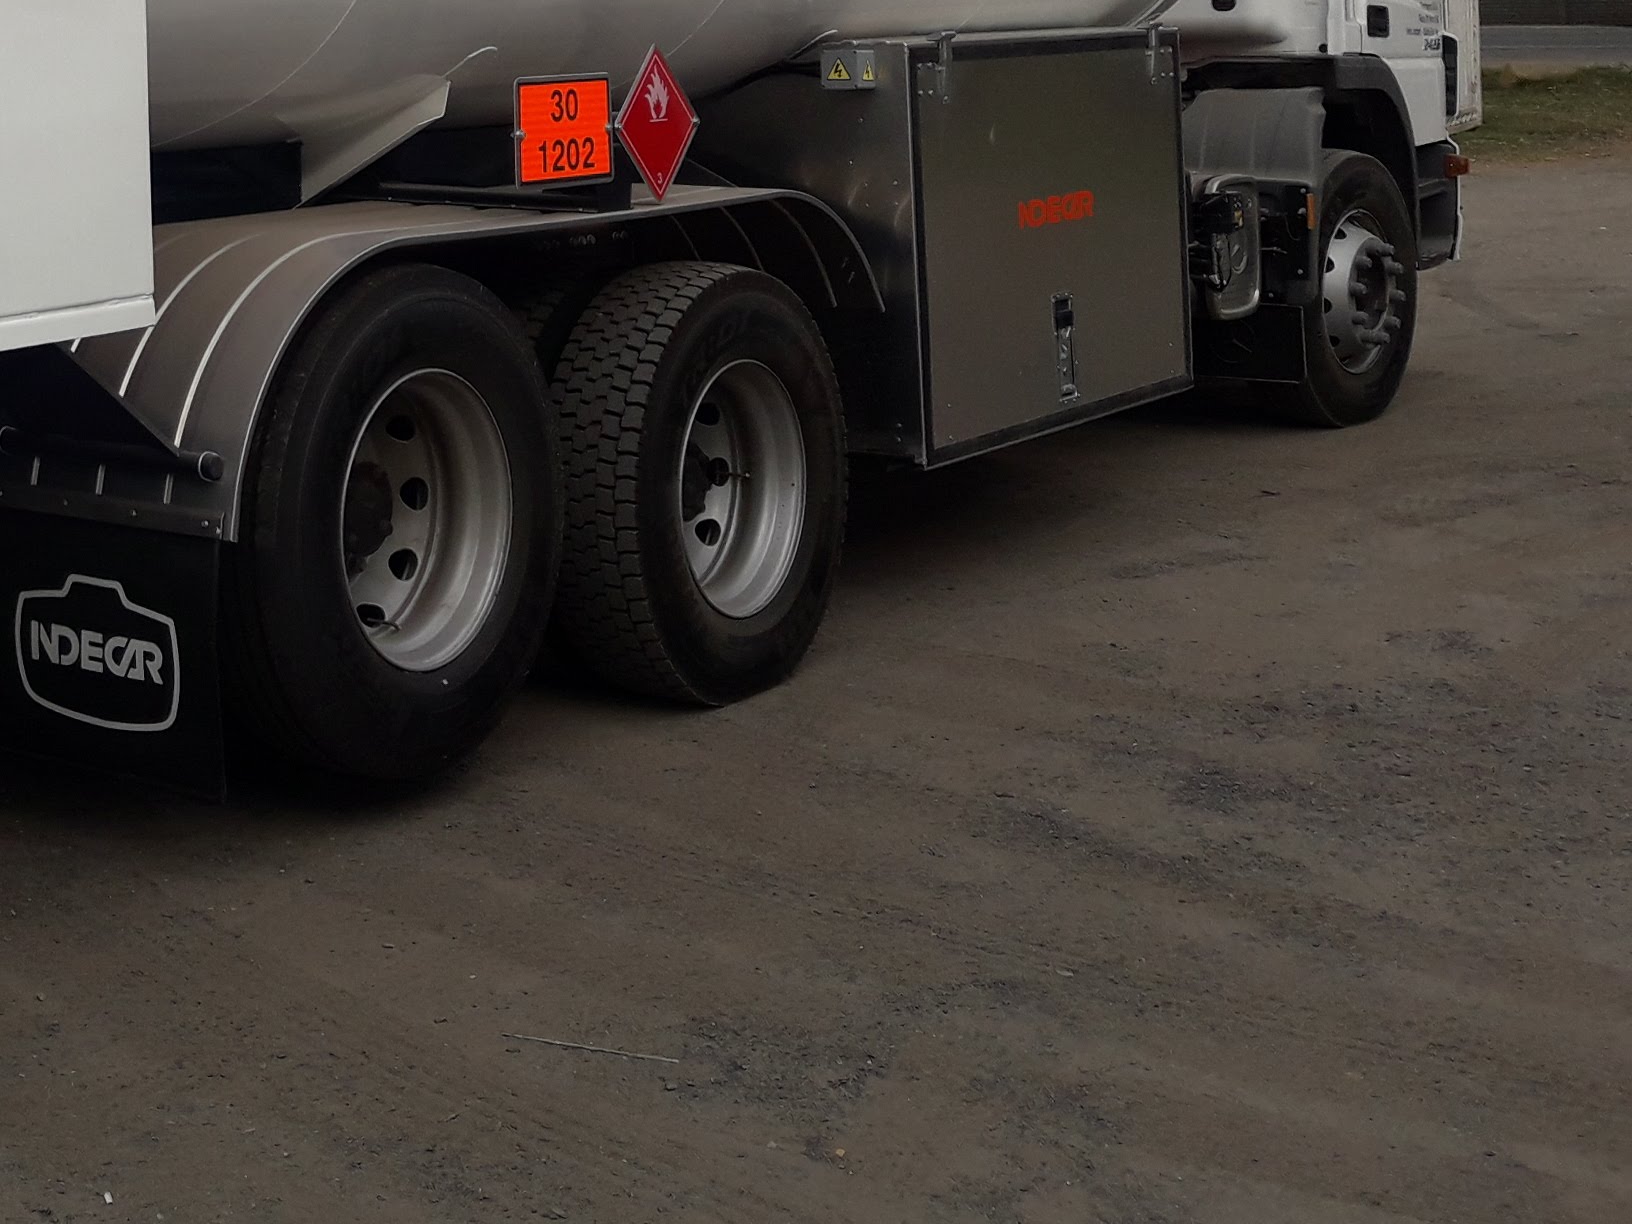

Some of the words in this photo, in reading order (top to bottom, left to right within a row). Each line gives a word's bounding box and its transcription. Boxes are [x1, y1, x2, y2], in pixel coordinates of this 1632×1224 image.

[550, 89, 579, 122] 30
[538, 137, 596, 173] 1202
[656, 172, 663, 184] 3
